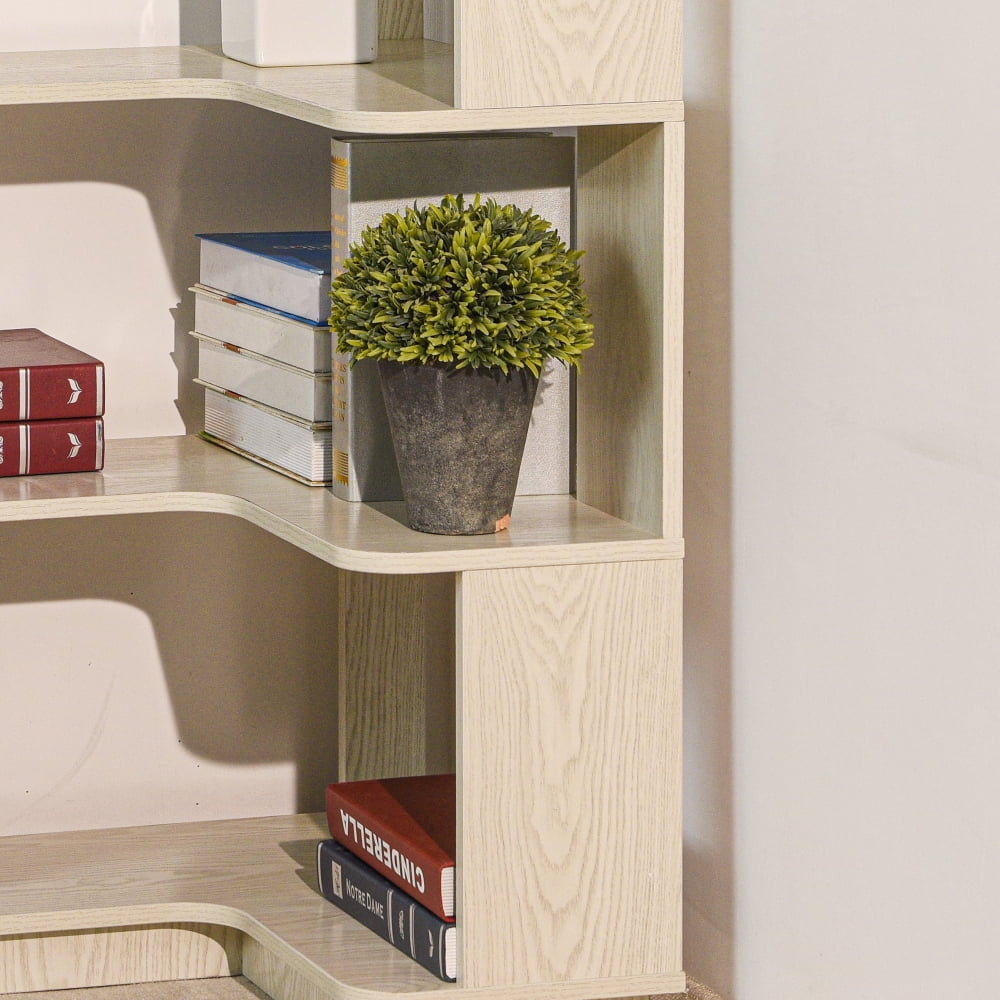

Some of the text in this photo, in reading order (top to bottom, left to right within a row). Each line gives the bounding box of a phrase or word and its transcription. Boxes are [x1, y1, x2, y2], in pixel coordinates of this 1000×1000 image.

[339, 808, 425, 894] CINDERELLA
[345, 878, 366, 908] NOTRE
[366, 892, 385, 920] DAME
